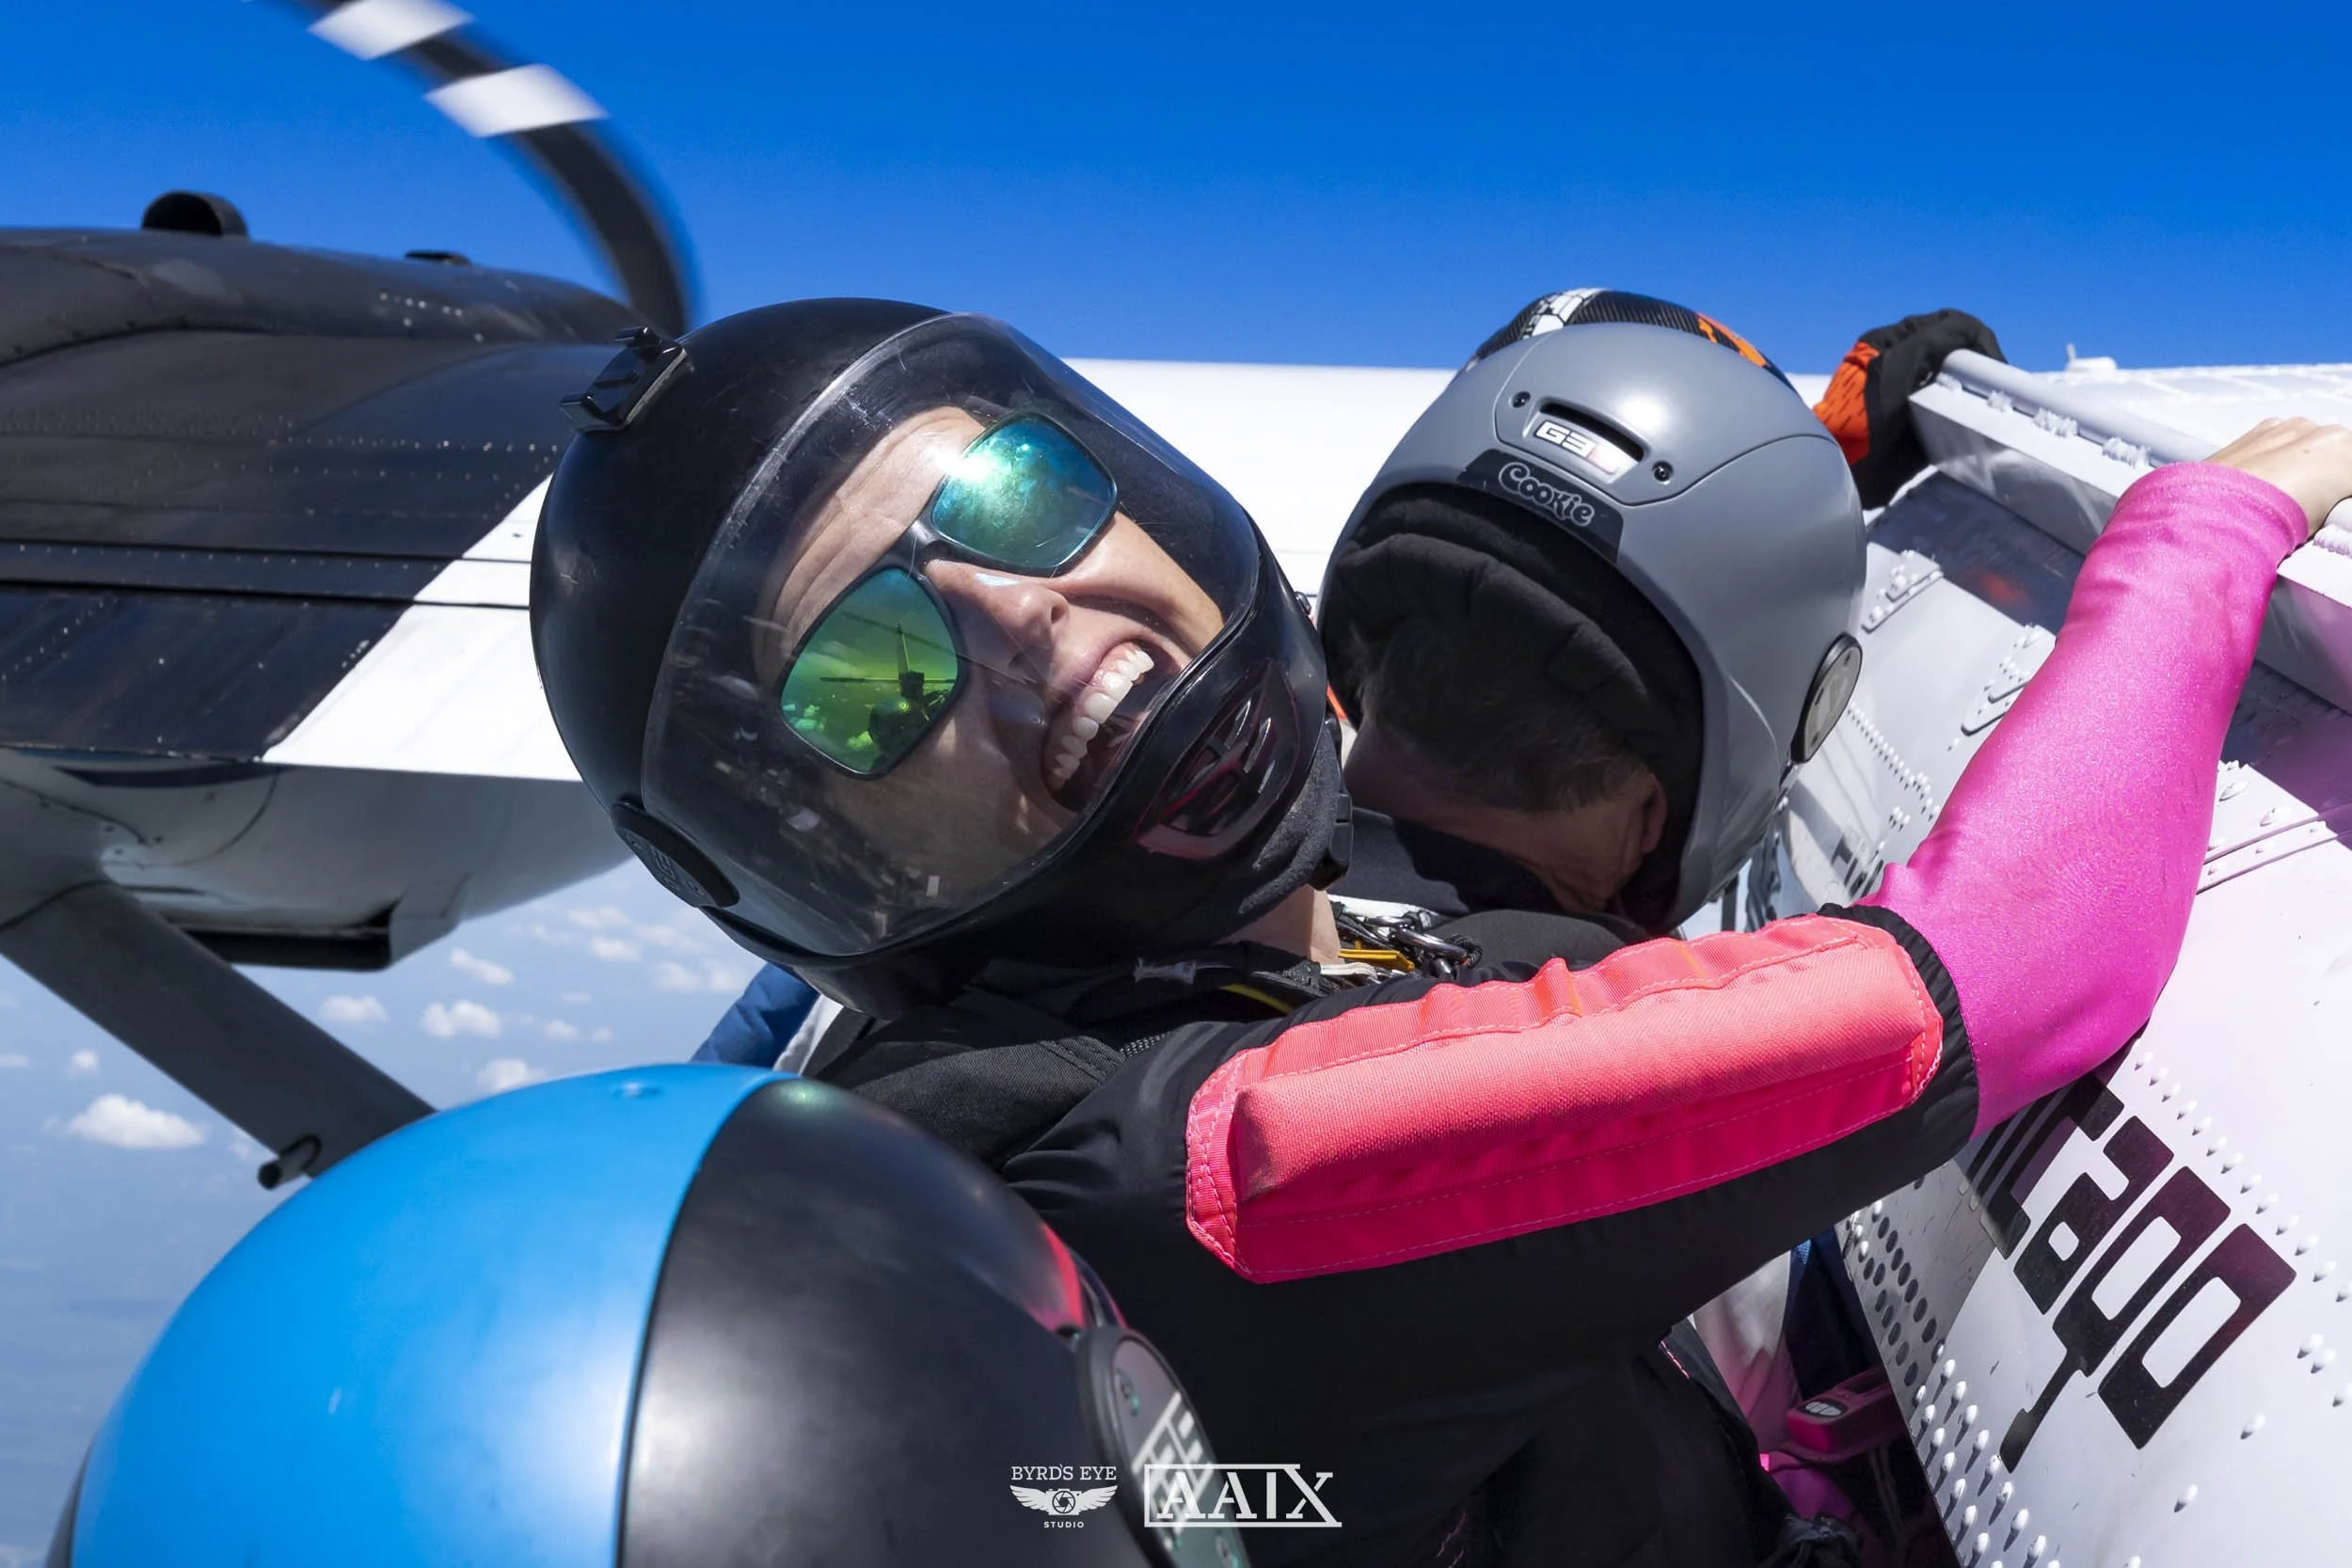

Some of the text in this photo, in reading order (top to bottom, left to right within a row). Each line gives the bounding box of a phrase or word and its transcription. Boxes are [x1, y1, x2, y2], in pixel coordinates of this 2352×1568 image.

[1533, 420, 1597, 459] G3
[1498, 461, 1596, 527] Cookie
[1966, 1070, 2297, 1474] icago
